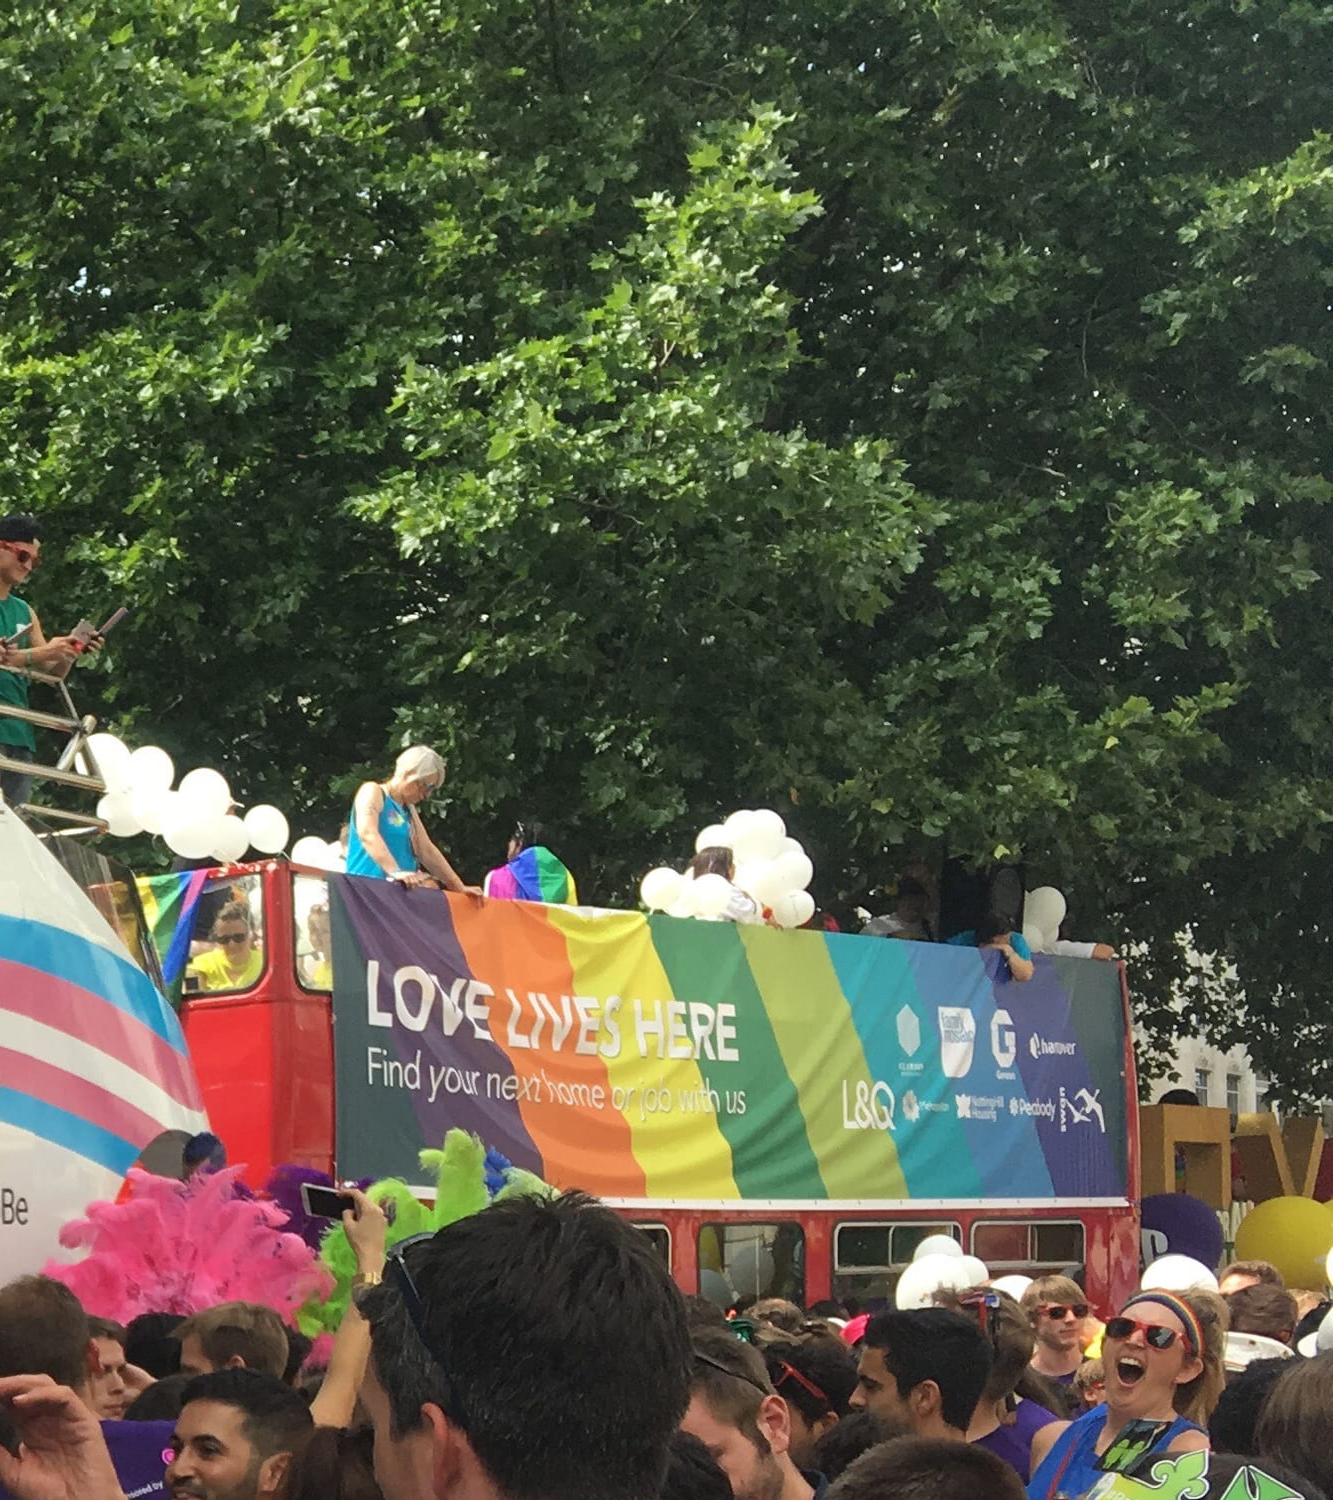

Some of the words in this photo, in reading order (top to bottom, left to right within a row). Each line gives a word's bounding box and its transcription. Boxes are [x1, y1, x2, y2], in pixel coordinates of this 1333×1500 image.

[366, 960, 495, 1043] LOVE
[506, 988, 622, 1059] LIVES
[633, 999, 740, 1062] HERE
[367, 1046, 422, 1090] Find
[428, 1064, 481, 1103] your
[487, 1072, 541, 1103] next
[540, 1068, 606, 1110] home
[612, 1085, 635, 1111] or
[638, 1077, 672, 1121] job
[678, 1077, 721, 1113] with
[725, 1090, 747, 1114] us
[842, 1080, 897, 1131] L&Q
[1019, 1097, 1056, 1121] Peabody
